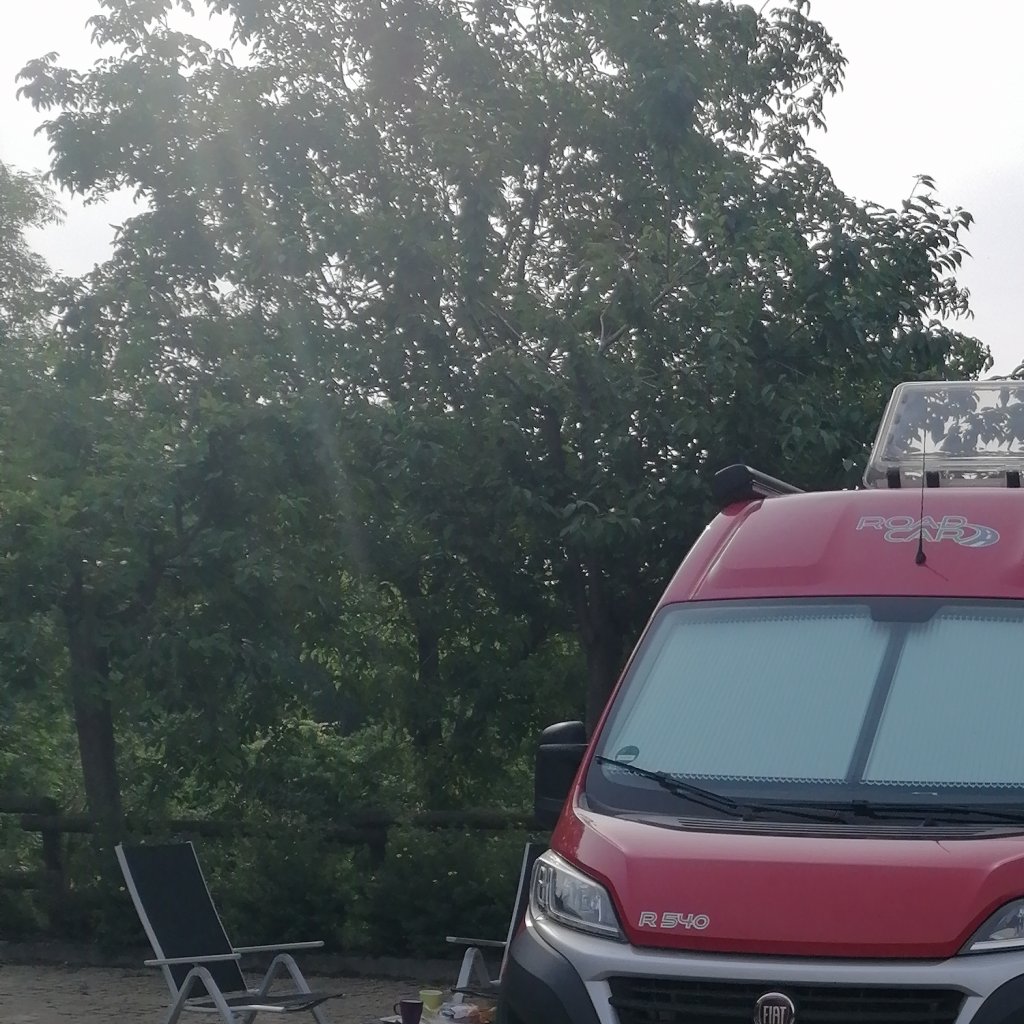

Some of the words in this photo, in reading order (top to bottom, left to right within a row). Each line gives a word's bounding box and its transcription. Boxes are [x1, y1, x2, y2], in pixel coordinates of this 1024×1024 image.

[856, 515, 968, 530] ROAD
[884, 527, 965, 543] CAR
[638, 911, 657, 928] R
[660, 912, 710, 930] 540
[763, 1005, 787, 1024] FIAT
